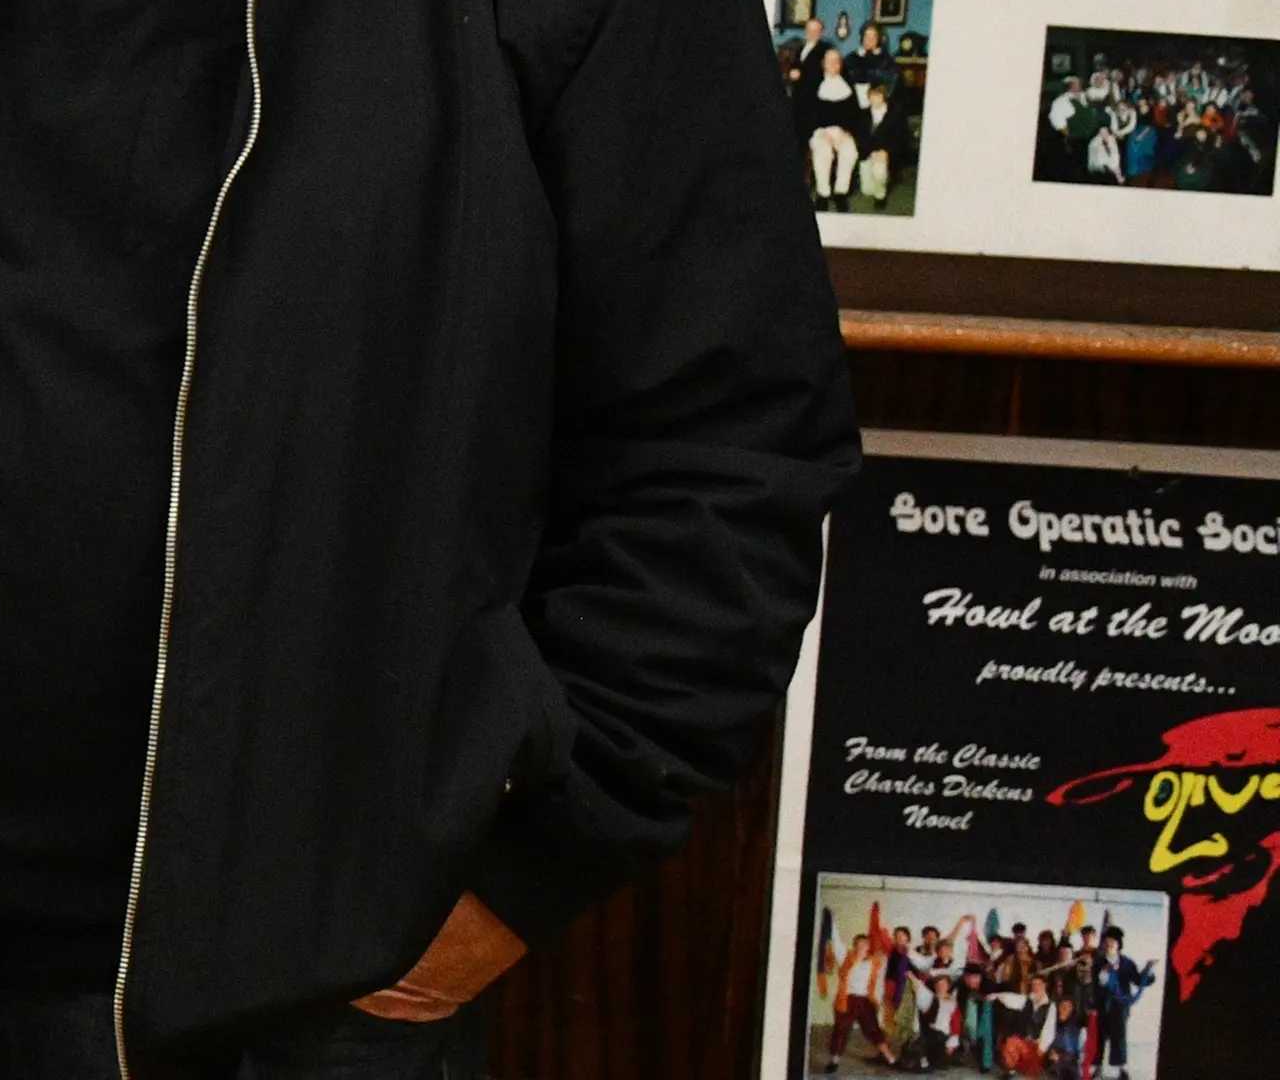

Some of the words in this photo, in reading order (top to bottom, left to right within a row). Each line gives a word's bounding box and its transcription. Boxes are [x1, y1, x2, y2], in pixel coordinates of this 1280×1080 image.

[1008, 499, 1184, 552] Operatic
[1039, 565, 1056, 579] in
[1059, 567, 1156, 588] association
[1160, 573, 1198, 590] with
[922, 587, 1043, 631] Howl
[1048, 606, 1099, 636] at
[1106, 601, 1169, 639] the
[1180, 603, 1280, 646] Moo
[975, 660, 1089, 692] proudly
[1090, 667, 1237, 695] presents...
[844, 736, 908, 762] From
[913, 742, 949, 764] the
[952, 743, 1041, 770] Classic
[843, 769, 936, 796] Charles
[941, 774, 1034, 802] Dickens
[902, 804, 975, 830] Novel
